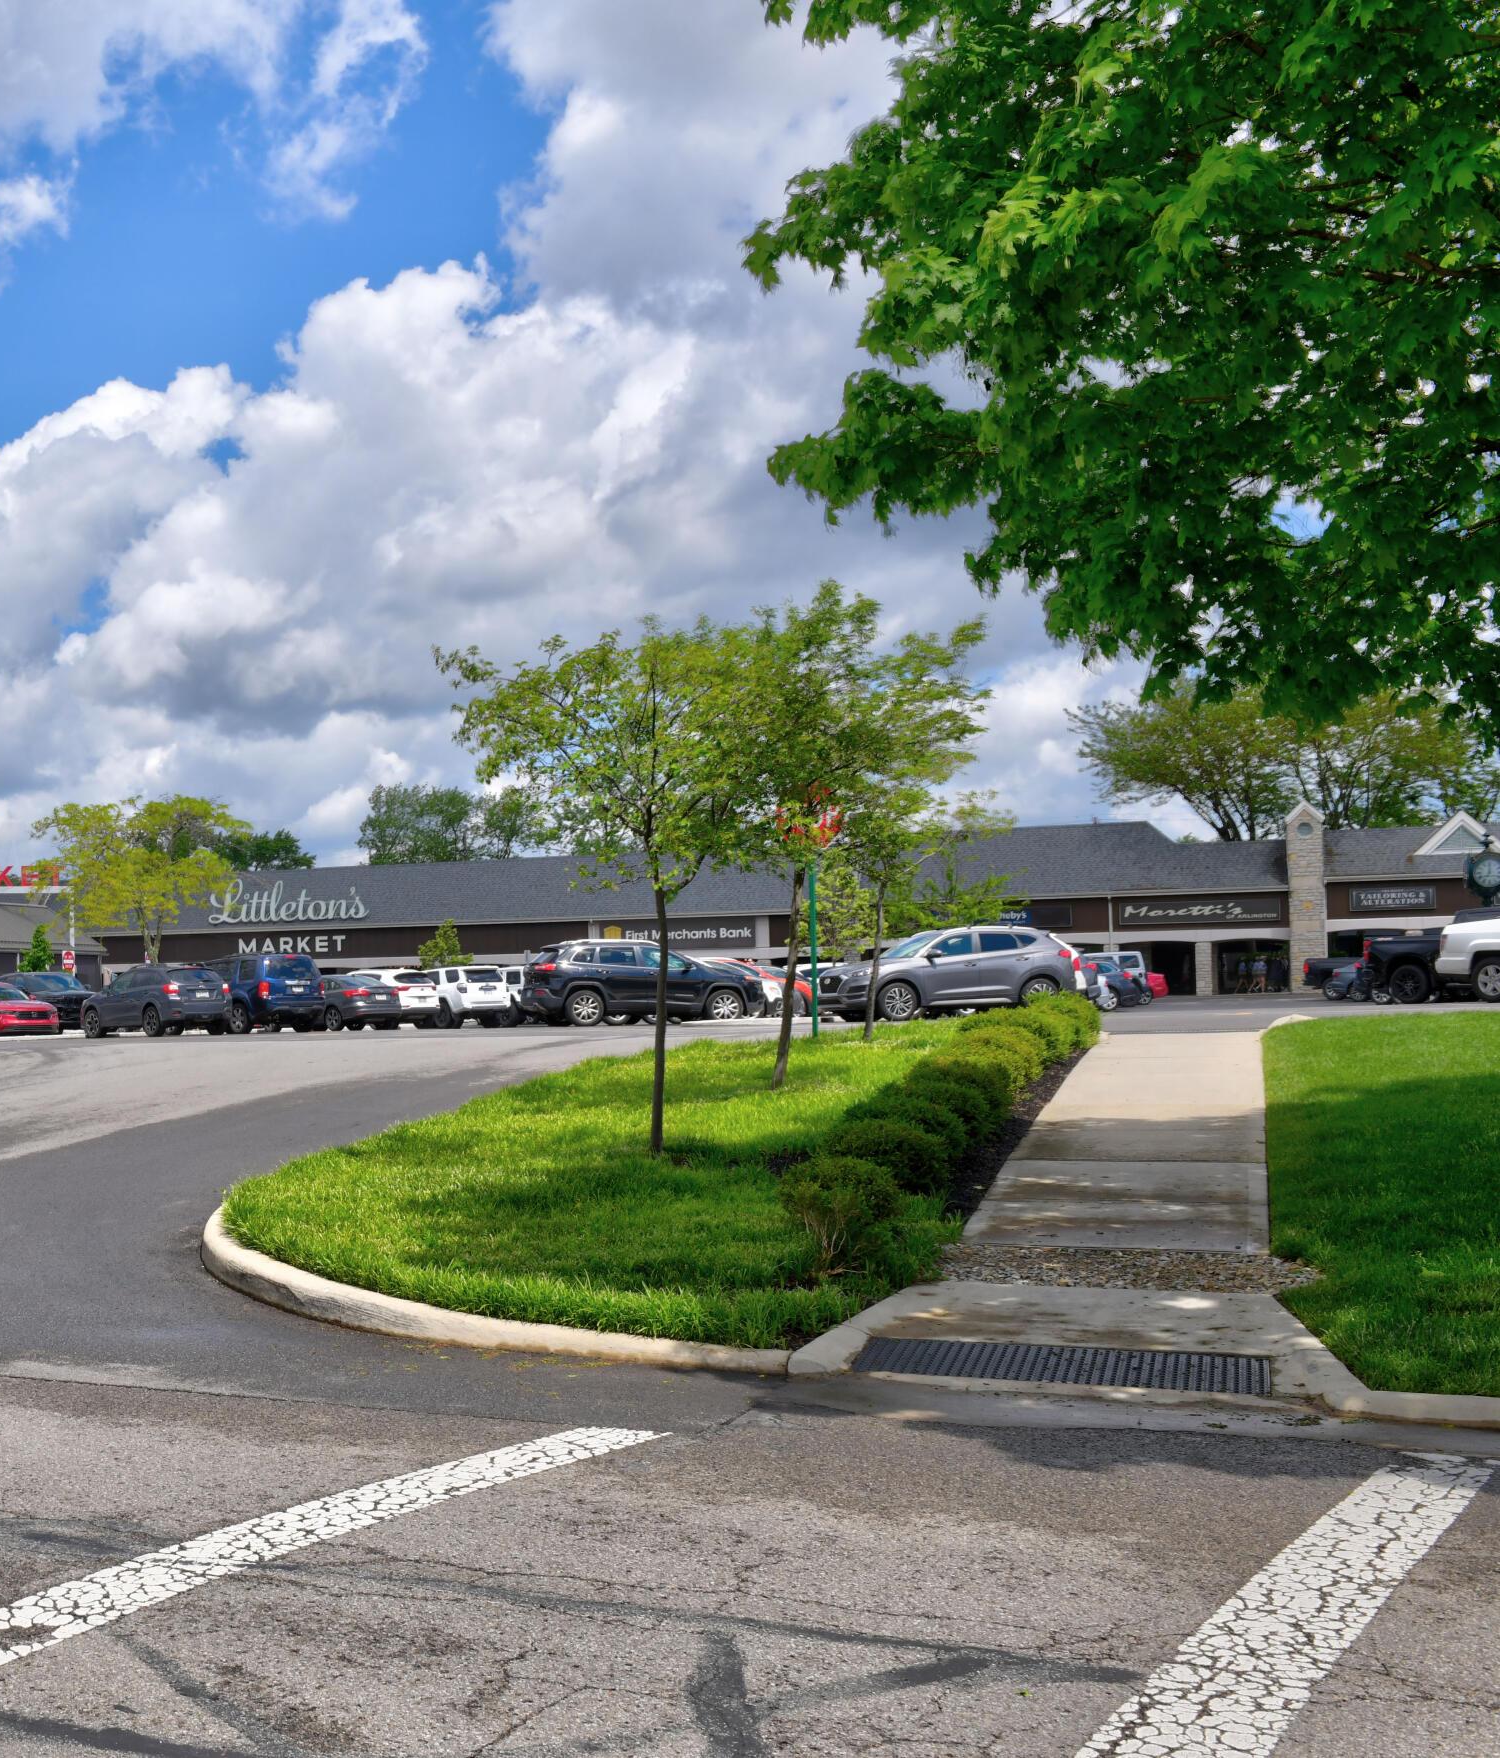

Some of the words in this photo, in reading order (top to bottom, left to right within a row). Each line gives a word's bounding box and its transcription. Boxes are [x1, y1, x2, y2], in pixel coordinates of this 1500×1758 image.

[208, 878, 369, 924] Littleton's
[1359, 892, 1417, 900] TAILORING
[1124, 902, 1243, 918] Moretti's
[625, 930, 648, 940] First
[652, 928, 717, 940] Merchants
[720, 926, 752, 939] Bank
[238, 935, 346, 954] MARKET
